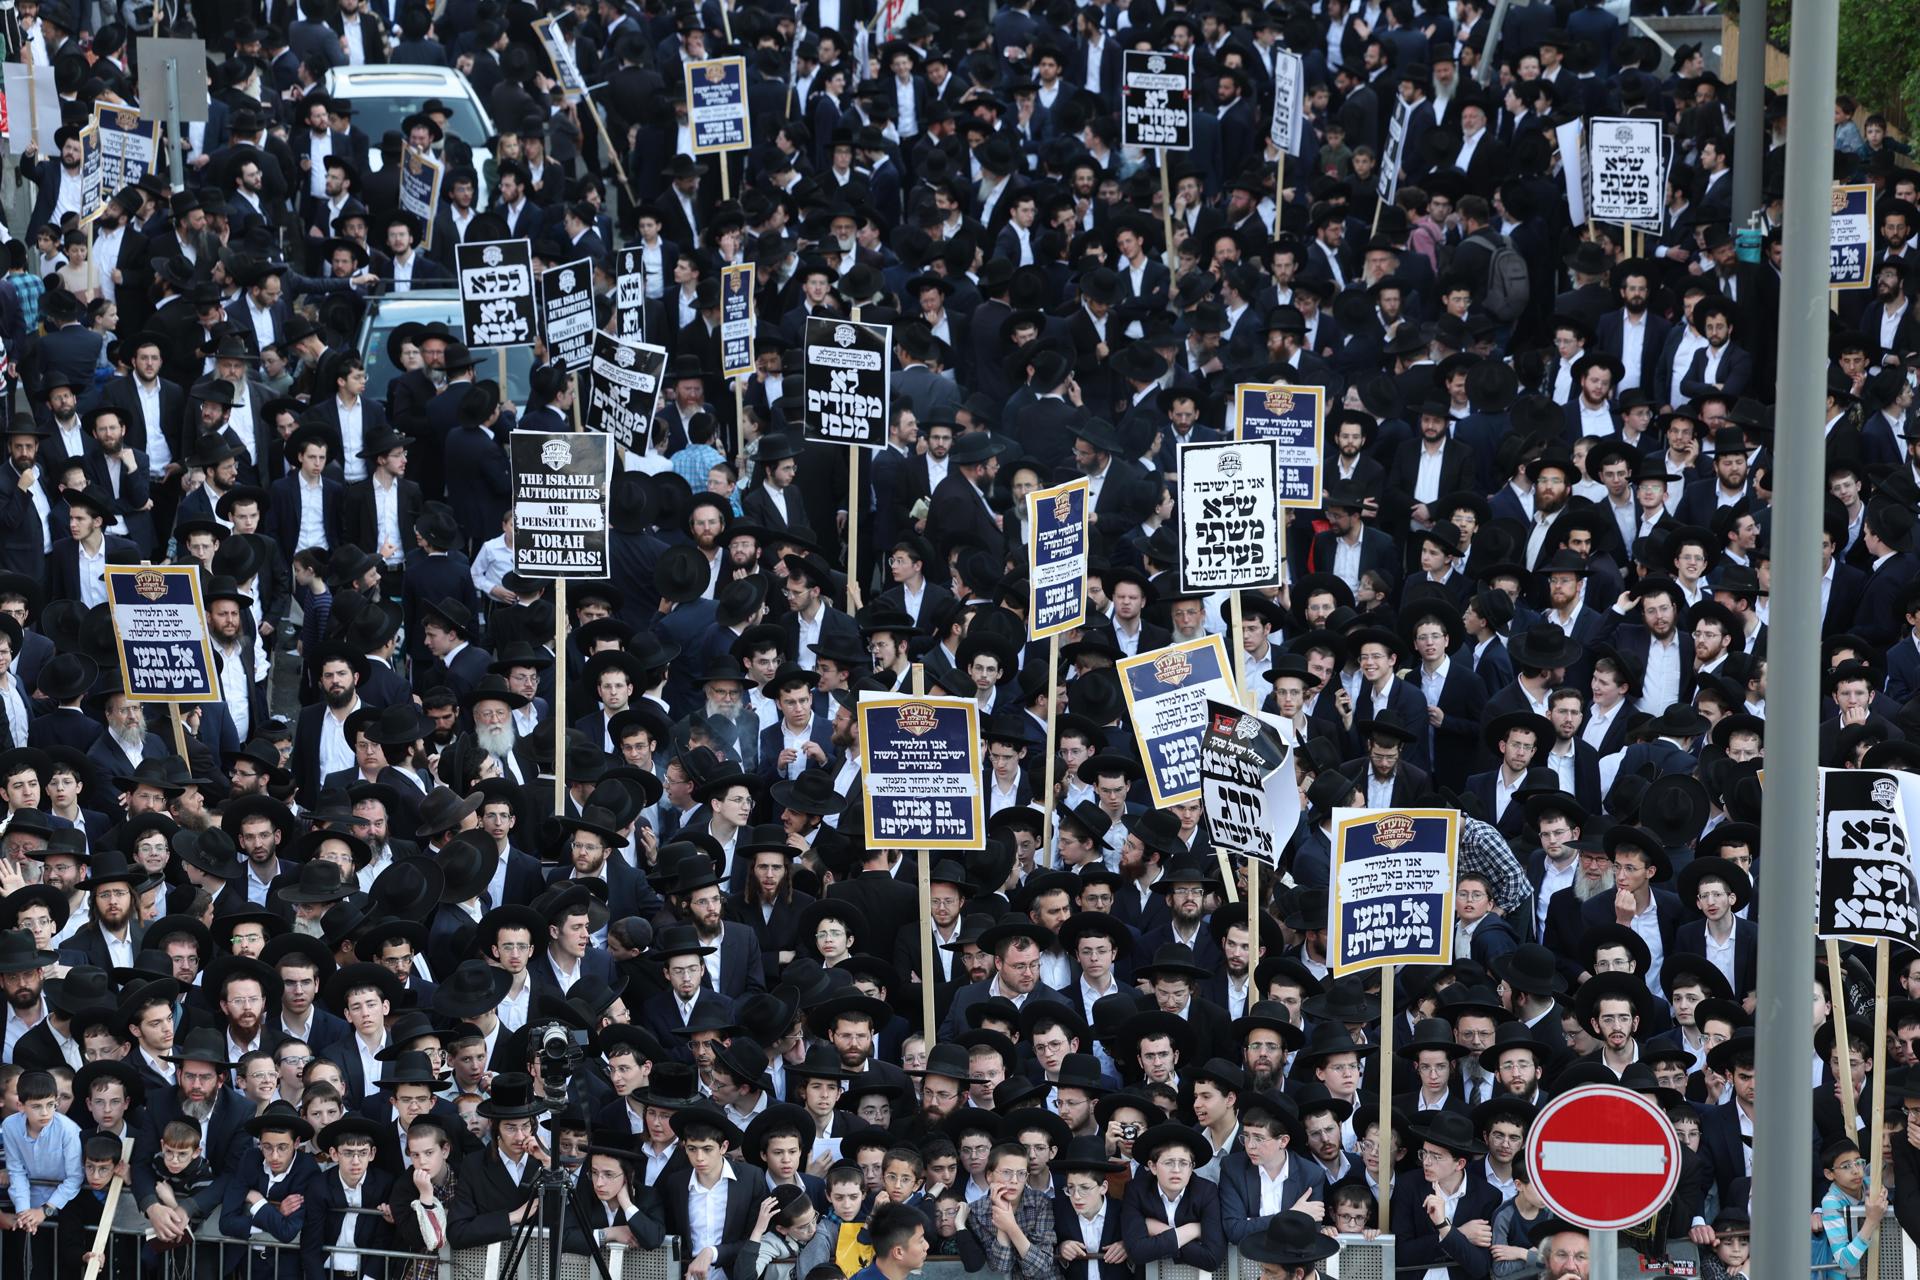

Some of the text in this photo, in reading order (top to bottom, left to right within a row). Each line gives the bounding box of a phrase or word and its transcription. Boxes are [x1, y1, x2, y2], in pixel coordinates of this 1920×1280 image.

[1145, 88, 1168, 108] לא
[1127, 106, 1188, 126] מפחדים
[1138, 123, 1177, 143] מכם!
[1636, 146, 1650, 154] אני
[1605, 155, 1644, 172] שלא
[1601, 187, 1648, 205] פעולה
[1842, 246, 1859, 265] אל
[470, 269, 521, 294] לכלא
[547, 289, 588, 310] THE ISRAELI
[480, 298, 517, 323] ולא
[548, 300, 591, 320] AUTHORITIES
[472, 317, 529, 344] לצבא
[552, 322, 589, 339] PERSECUTING
[566, 317, 576, 326] ARE
[558, 335, 586, 354] TORAH
[830, 368, 859, 394] לא
[609, 382, 631, 408] לא
[808, 389, 882, 418] מפחדים
[593, 387, 648, 434] מפחדים
[600, 410, 633, 447] מכם!
[821, 412, 870, 439] מכם!
[1246, 416, 1312, 428] אנו תלמידי ישיבת
[519, 473, 595, 486] THE ISRAELI
[1287, 468, 1300, 482] גם
[518, 487, 600, 499] AUTHORITIES
[1194, 477, 1264, 494] אני בן ישיבה
[1286, 483, 1309, 496] נהיה
[547, 505, 568, 515] ARE
[1202, 493, 1257, 519] שלא
[522, 517, 596, 528] PERSECUTING
[1196, 519, 1265, 545] משתף
[532, 534, 585, 548] TORAH
[518, 549, 602, 565] SCHOLARS!
[1198, 542, 1264, 568] פעולה
[1192, 566, 1270, 584] עם חוק השמד
[1045, 583, 1074, 605] גם אנחנו
[134, 607, 178, 617] אנו תלמידי
[1038, 598, 1078, 624] נהיה עריקים!
[133, 619, 155, 629] חברון
[129, 628, 192, 640] קוראים לשלטון:
[133, 644, 195, 667] אל תגעו
[133, 667, 203, 688] בישיבות!
[1156, 688, 1206, 707] אנו תלמידי
[1156, 707, 1182, 722] חברון
[1152, 717, 1188, 735] לשלטון:
[890, 738, 947, 750] אנו תלמידי
[1159, 735, 1200, 765] תגעו
[1227, 739, 1246, 754] ישראל
[874, 750, 965, 760] ישיבת הדרת משה
[1202, 748, 1238, 779] לצבא
[898, 761, 942, 770] מצהירים
[876, 784, 906, 793] במלואו
[932, 775, 944, 784] לא
[943, 786, 967, 794] תורתו
[892, 800, 952, 817] גם אנחנו
[1217, 785, 1262, 825] יהרג
[881, 818, 966, 836] נהיה עריקים!
[1212, 818, 1273, 853] אל יעבור!
[1841, 817, 1911, 863] כלא
[1364, 857, 1422, 870] אנו תלמידי
[1348, 870, 1440, 886] ישיבת באר מרדכי
[1852, 864, 1910, 904] ולא
[1352, 881, 1433, 900] קוראים לשלטון:
[1353, 898, 1430, 930] אל תגעו
[1834, 898, 1919, 940] לצבא
[1347, 925, 1434, 957] בישיבות!
